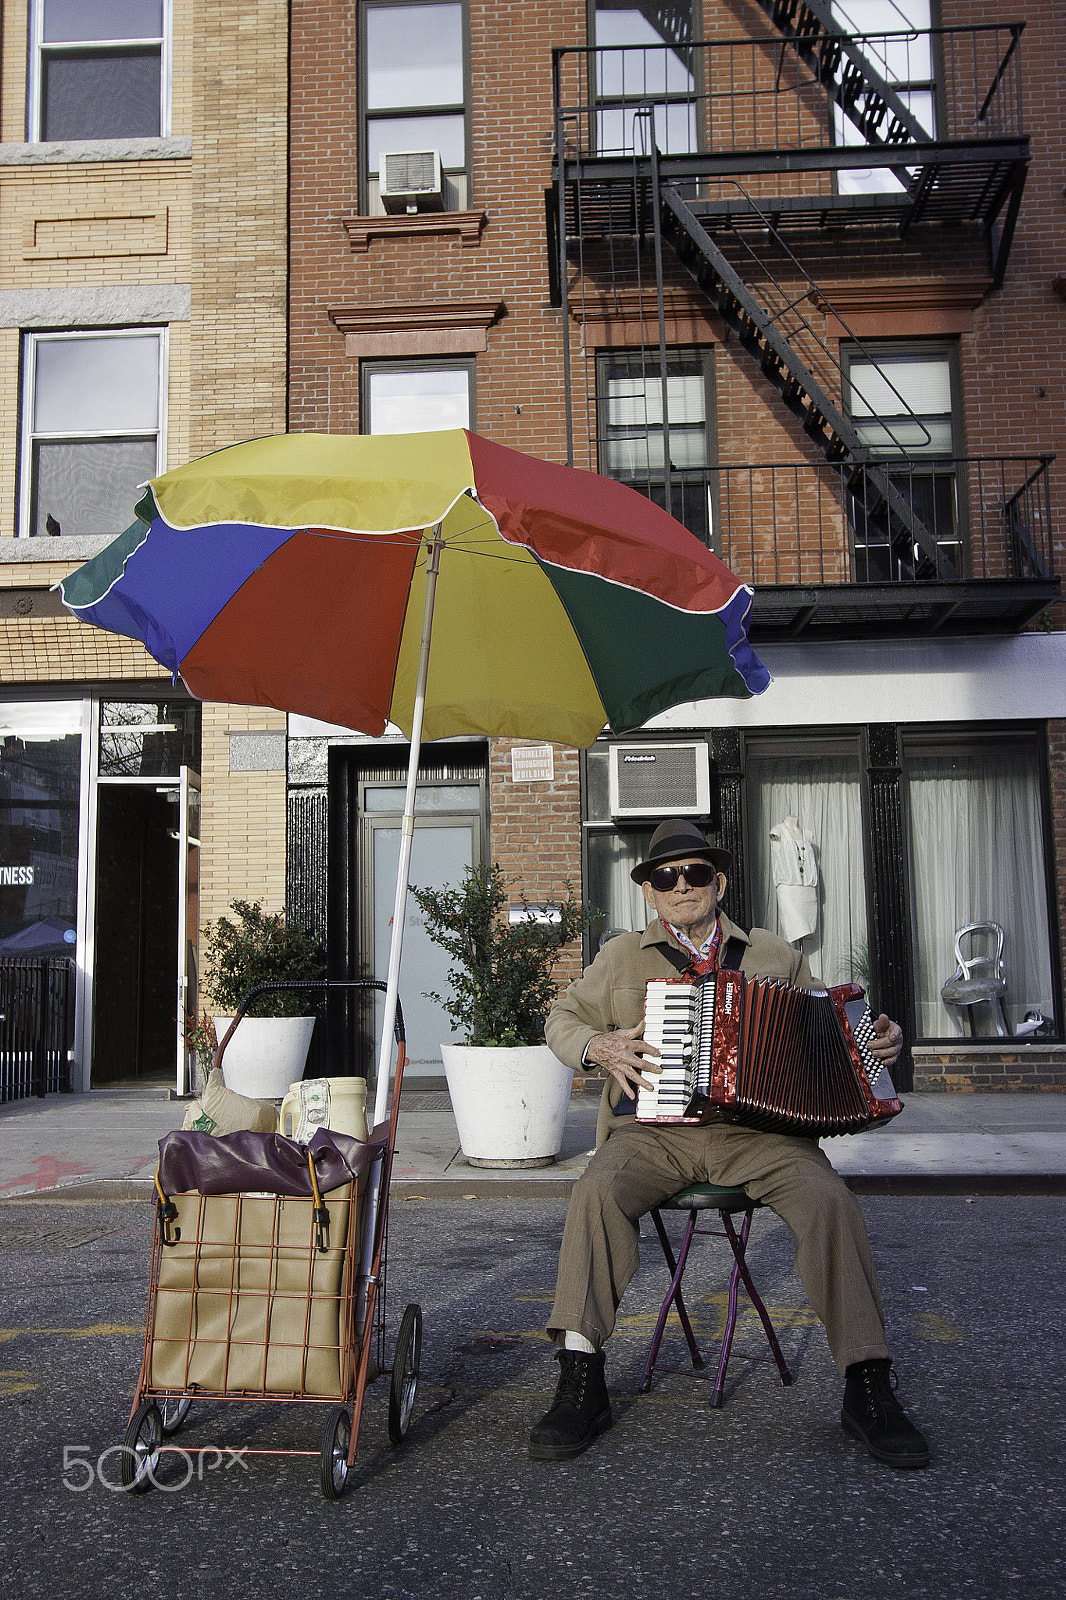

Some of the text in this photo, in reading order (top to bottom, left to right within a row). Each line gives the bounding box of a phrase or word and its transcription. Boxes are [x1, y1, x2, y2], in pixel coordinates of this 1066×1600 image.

[514, 749, 551, 759] SPRINKLERS
[514, 759, 551, 769] THROUGHOUT
[516, 769, 551, 779] BUILDING
[724, 982, 734, 1015] HOHNER
